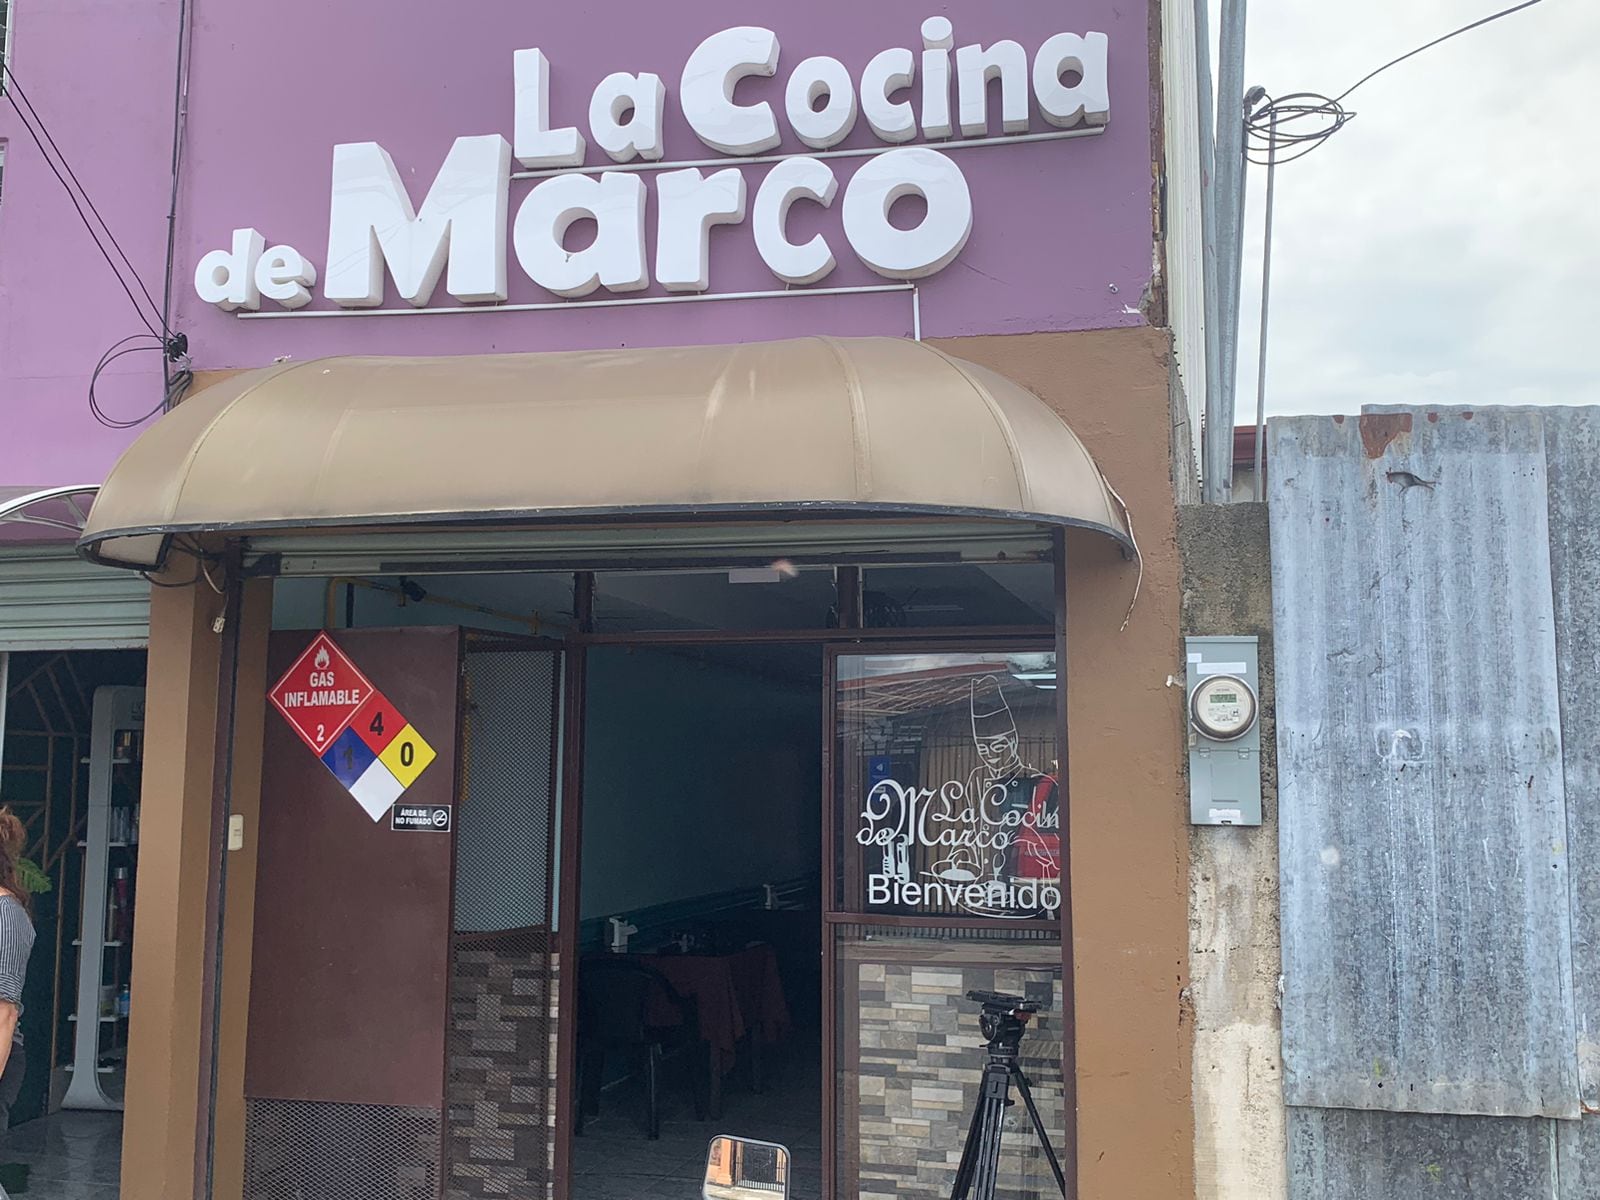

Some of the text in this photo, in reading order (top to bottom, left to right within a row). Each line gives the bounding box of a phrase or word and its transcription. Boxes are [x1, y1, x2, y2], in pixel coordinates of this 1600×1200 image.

[513, 15, 1110, 168] La Cocina
[194, 134, 973, 310] de Marco
[310, 672, 334, 686] GAS
[285, 690, 359, 707] INFLAMABLE
[316, 724, 325, 742] 2
[370, 712, 384, 735] 4
[343, 747, 354, 770] 1
[401, 742, 414, 766] 0
[418, 809, 427, 817] DE
[866, 780, 1009, 849] Marco
[932, 781, 1059, 828] La Cocin
[395, 817, 432, 825] NO FUMADO
[869, 874, 1061, 910] Bienvenido
